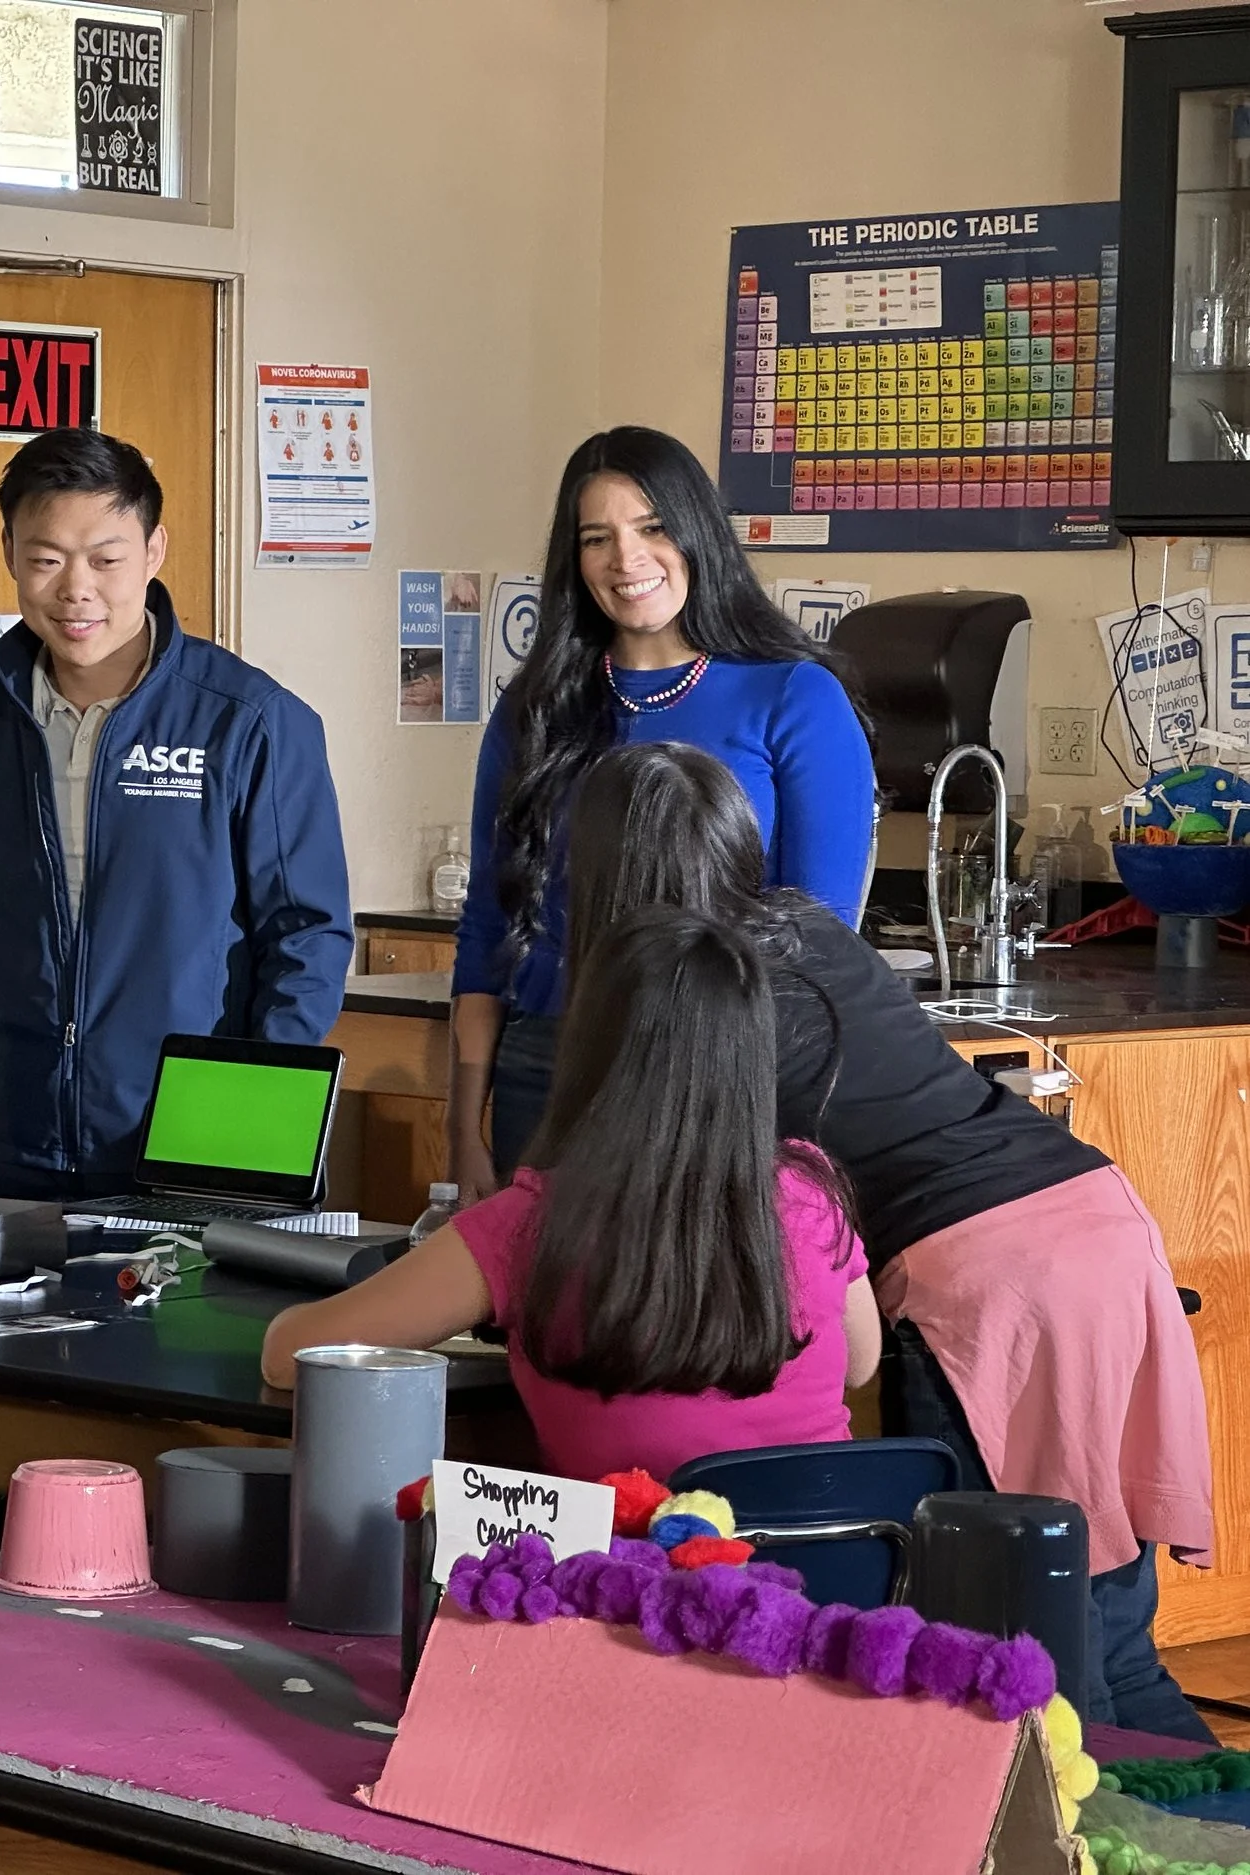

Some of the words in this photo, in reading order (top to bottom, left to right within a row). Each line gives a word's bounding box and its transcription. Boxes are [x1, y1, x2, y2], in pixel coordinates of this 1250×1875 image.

[77, 26, 159, 61] SCIENCE
[77, 55, 113, 82] IT'S
[118, 60, 159, 87] LIKE
[77, 81, 159, 139] Magic
[79, 162, 113, 187] BUT
[117, 166, 159, 192] REAL
[808, 226, 849, 247] THE
[855, 218, 957, 245] PERIODIC
[965, 213, 1039, 237] TABLE
[760, 332, 772, 342] Mg
[759, 359, 768, 367] Ca
[839, 356, 847, 364] Cr
[859, 355, 871, 363] Mn
[879, 354, 888, 362] Fe
[919, 353, 929, 361] Ni
[964, 351, 975, 359] Zn
[271, 368, 298, 378] NOVEL
[299, 368, 356, 379] CORONAVIRUS
[757, 385, 765, 393] Sr
[819, 383, 829, 391] Nb
[839, 383, 850, 391] Mo
[879, 381, 889, 389] Ru
[920, 379, 930, 388] Pd
[942, 378, 953, 388] Ag
[964, 377, 975, 386] Cd
[756, 411, 766, 419] Ba
[920, 407, 929, 415] Pt
[965, 405, 976, 415] Hg
[755, 438, 765, 446] Ra
[1061, 524, 1110, 533] ScienceFlix
[406, 583, 435, 593] WASH
[407, 602, 435, 614] YOUR
[402, 623, 440, 634] HANDS!
[1123, 624, 1199, 653] Mathematics
[122, 744, 206, 774] ASCE
[153, 777, 168, 785] LOS
[170, 777, 203, 787] ANGELES
[124, 788, 153, 796] YOUNGER
[154, 789, 179, 797] MEMBER
[180, 791, 202, 799] FORUM
[463, 1467, 560, 1522] Shopping
